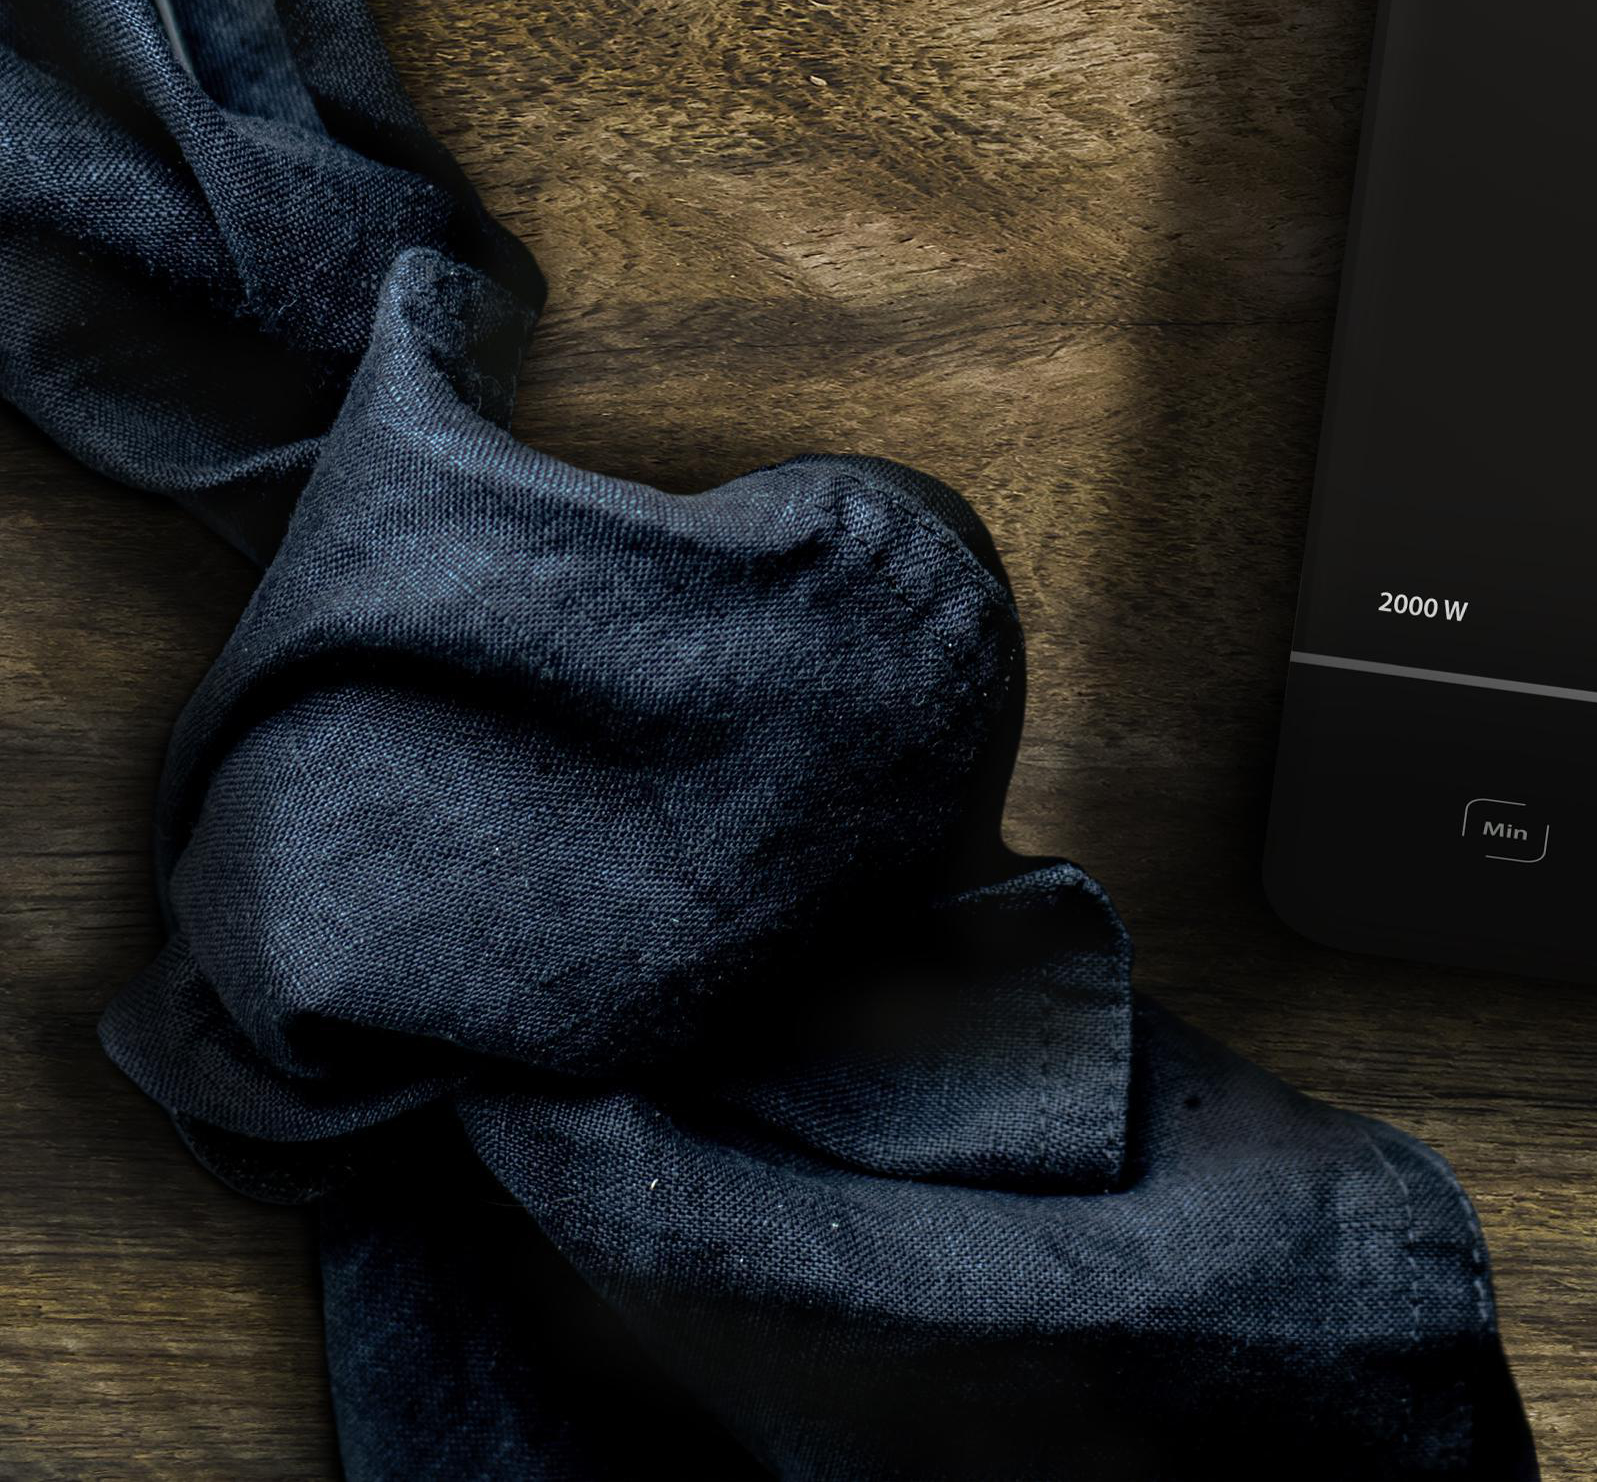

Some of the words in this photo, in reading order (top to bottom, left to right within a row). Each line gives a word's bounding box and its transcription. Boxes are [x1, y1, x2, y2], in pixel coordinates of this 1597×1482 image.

[1377, 591, 1439, 618] 2000
[1444, 599, 1469, 622] W
[1482, 821, 1528, 841] Min
